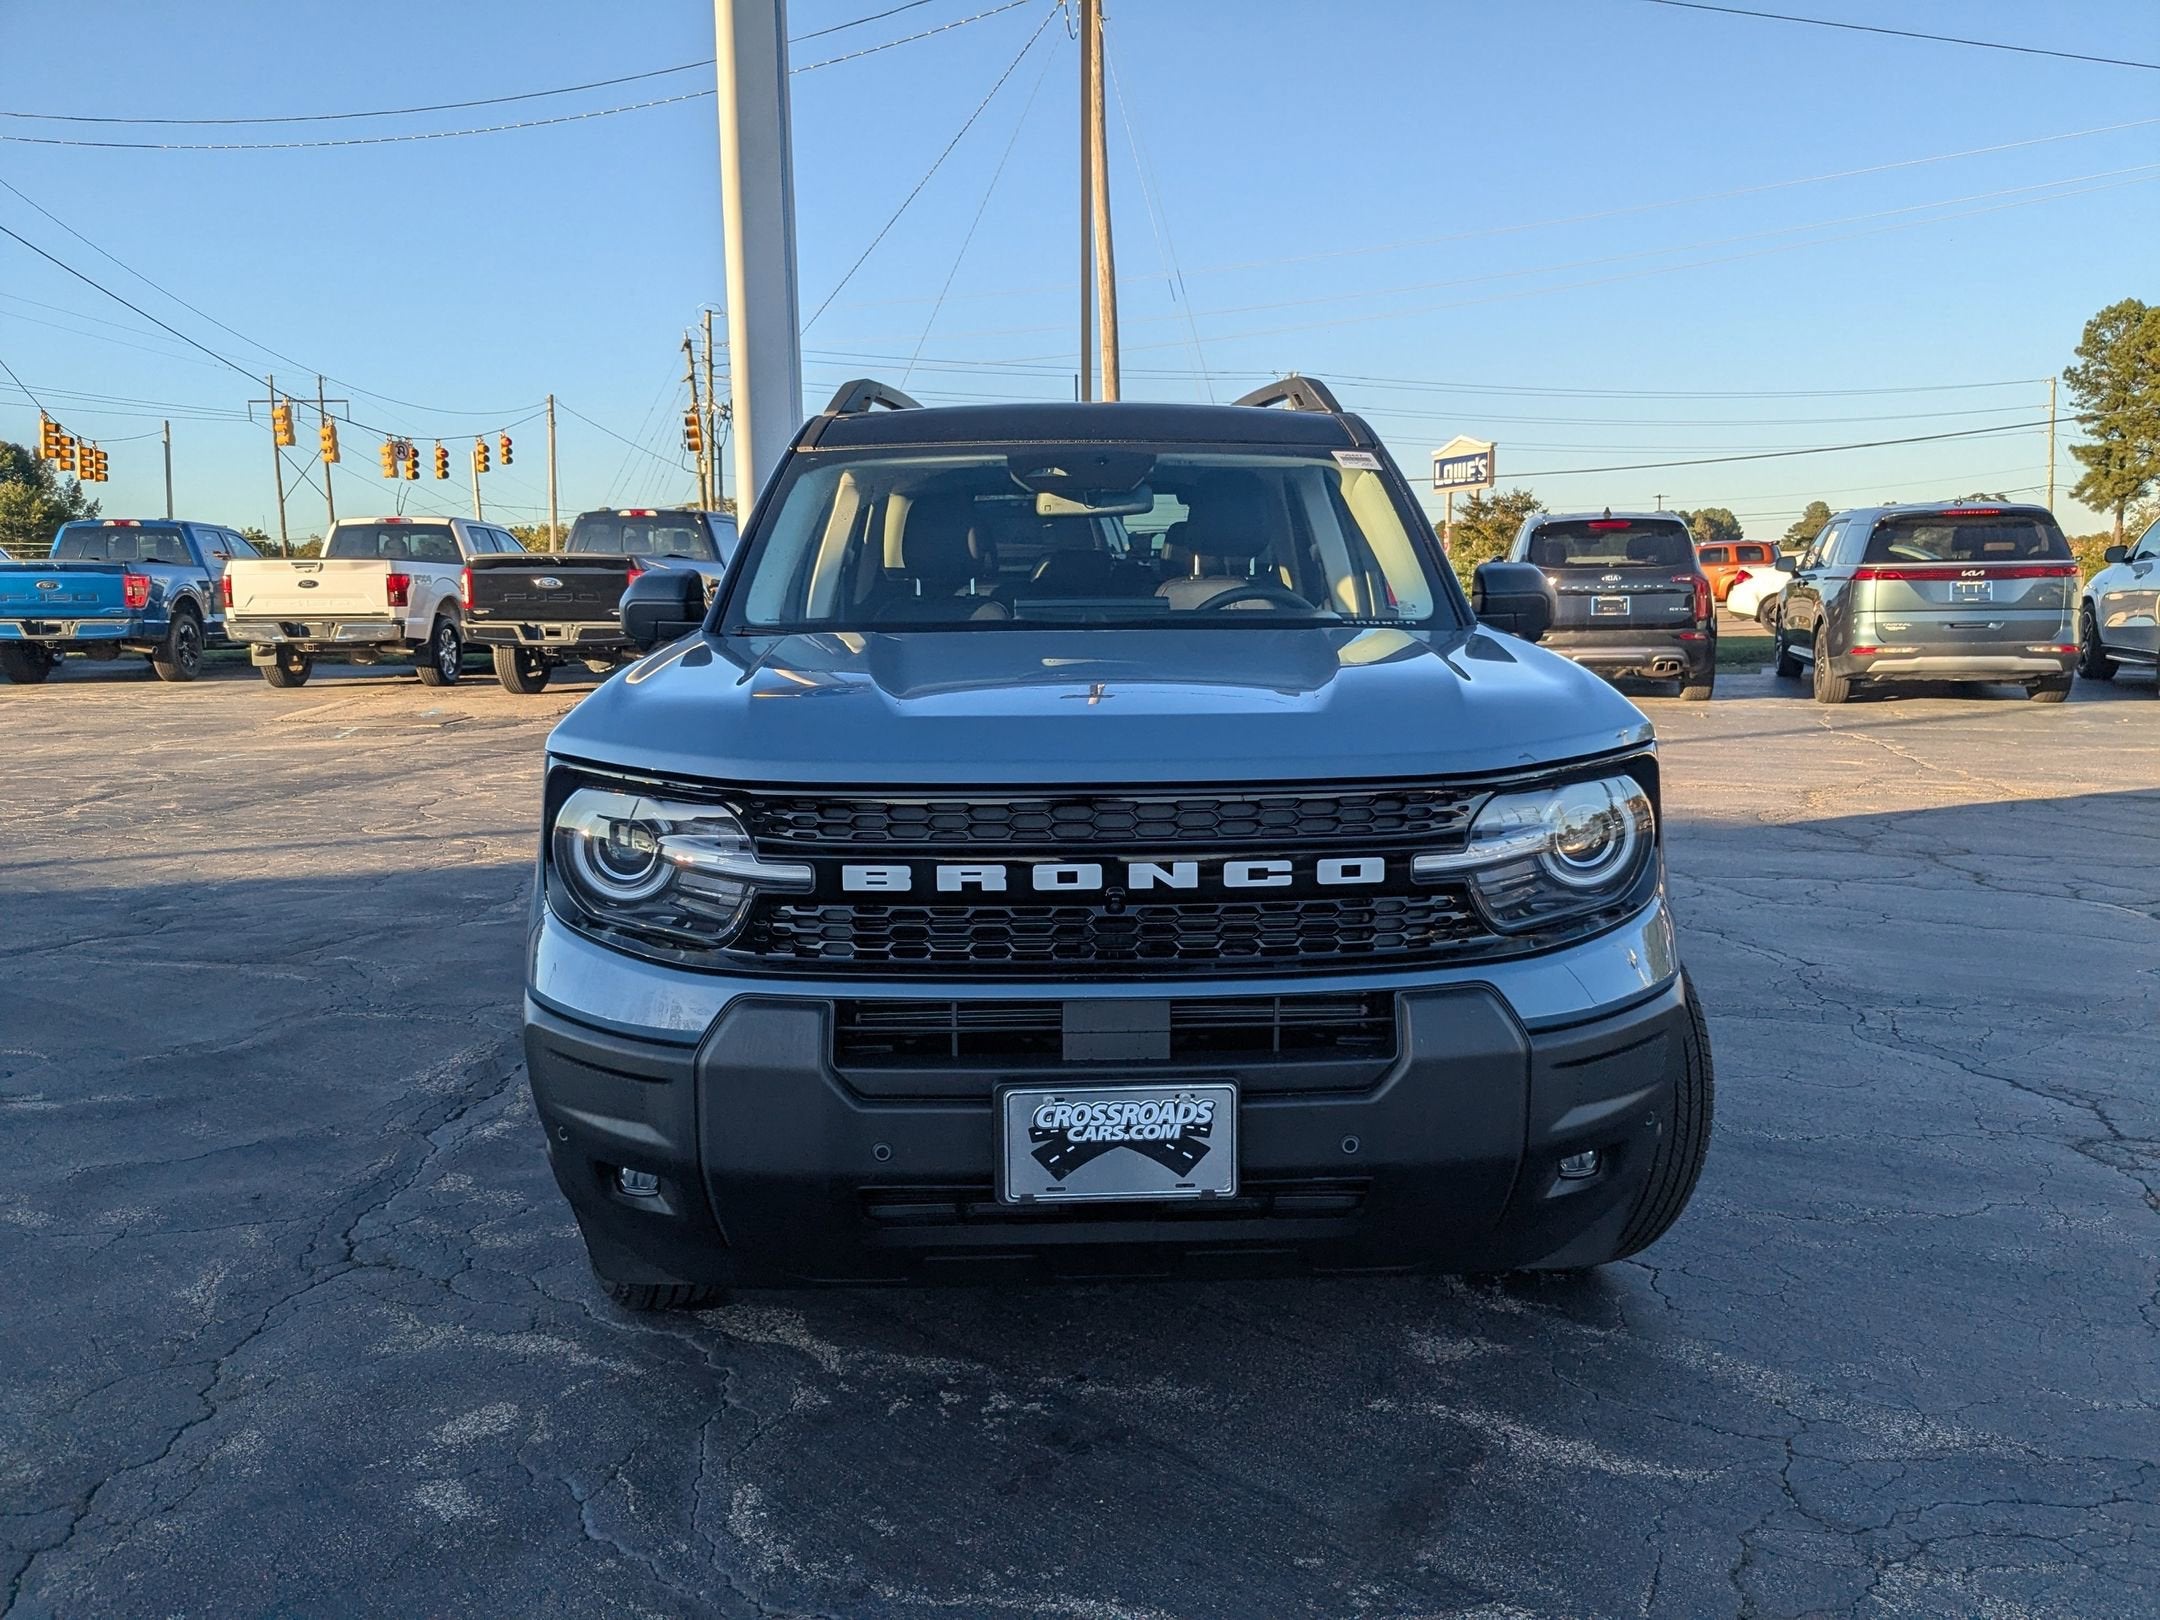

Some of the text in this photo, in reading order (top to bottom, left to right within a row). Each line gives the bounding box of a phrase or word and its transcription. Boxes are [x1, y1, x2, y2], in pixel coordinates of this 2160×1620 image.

[1434, 457, 1488, 486] LOWE'S
[499, 592, 601, 603] F-150
[841, 857, 1385, 893] BRONCO
[1034, 1100, 1215, 1128] CROSSROADS
[1066, 1122, 1182, 1142] CARS.COM
